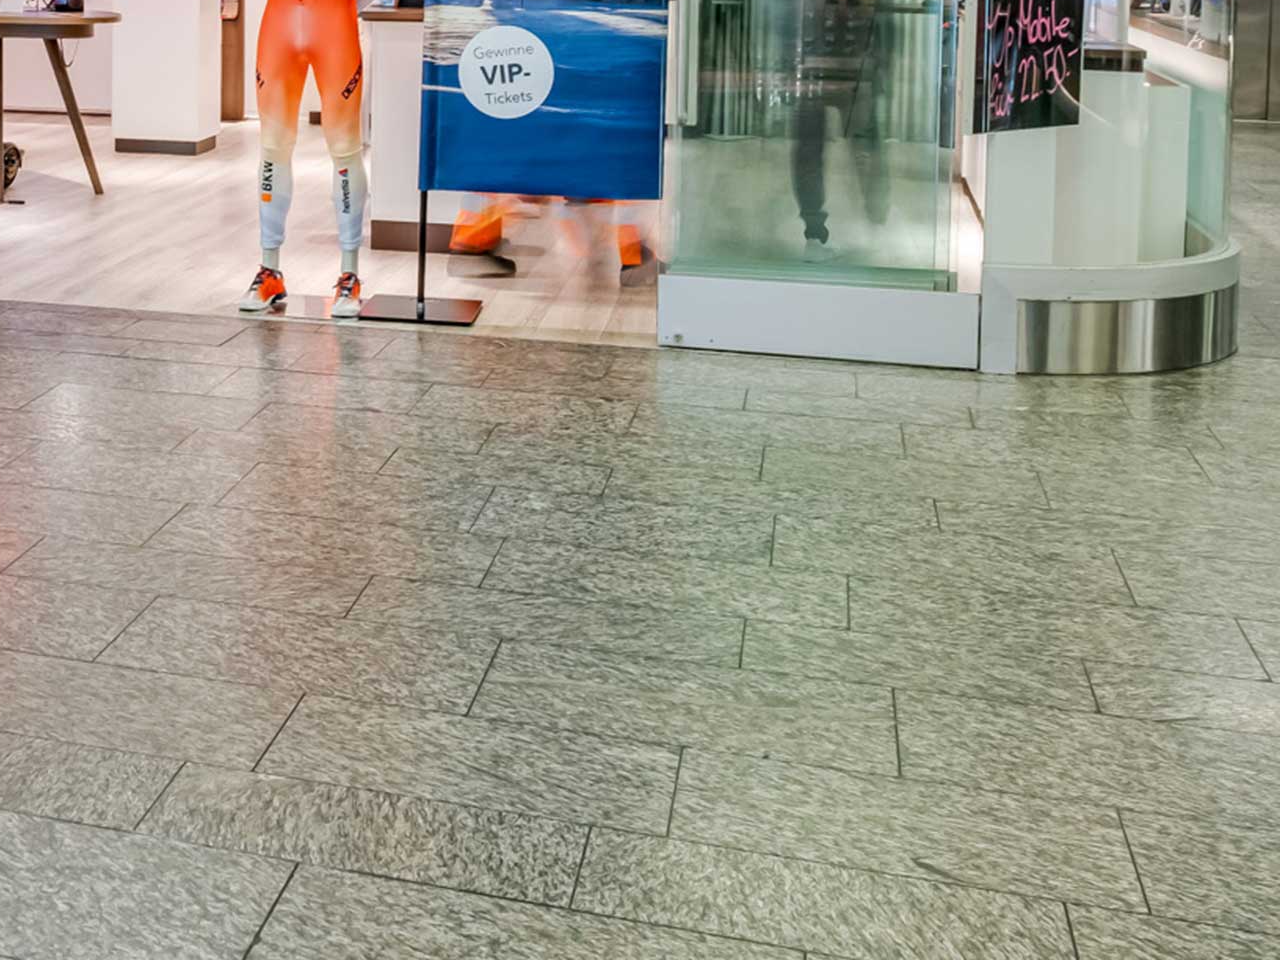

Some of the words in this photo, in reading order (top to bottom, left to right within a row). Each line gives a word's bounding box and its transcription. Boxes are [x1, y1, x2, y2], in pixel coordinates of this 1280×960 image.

[473, 43, 535, 59] Gewinne
[480, 63, 531, 85] VIP-
[484, 90, 533, 105] Tickets
[261, 160, 273, 192] BKW
[341, 179, 351, 214] helvetia
